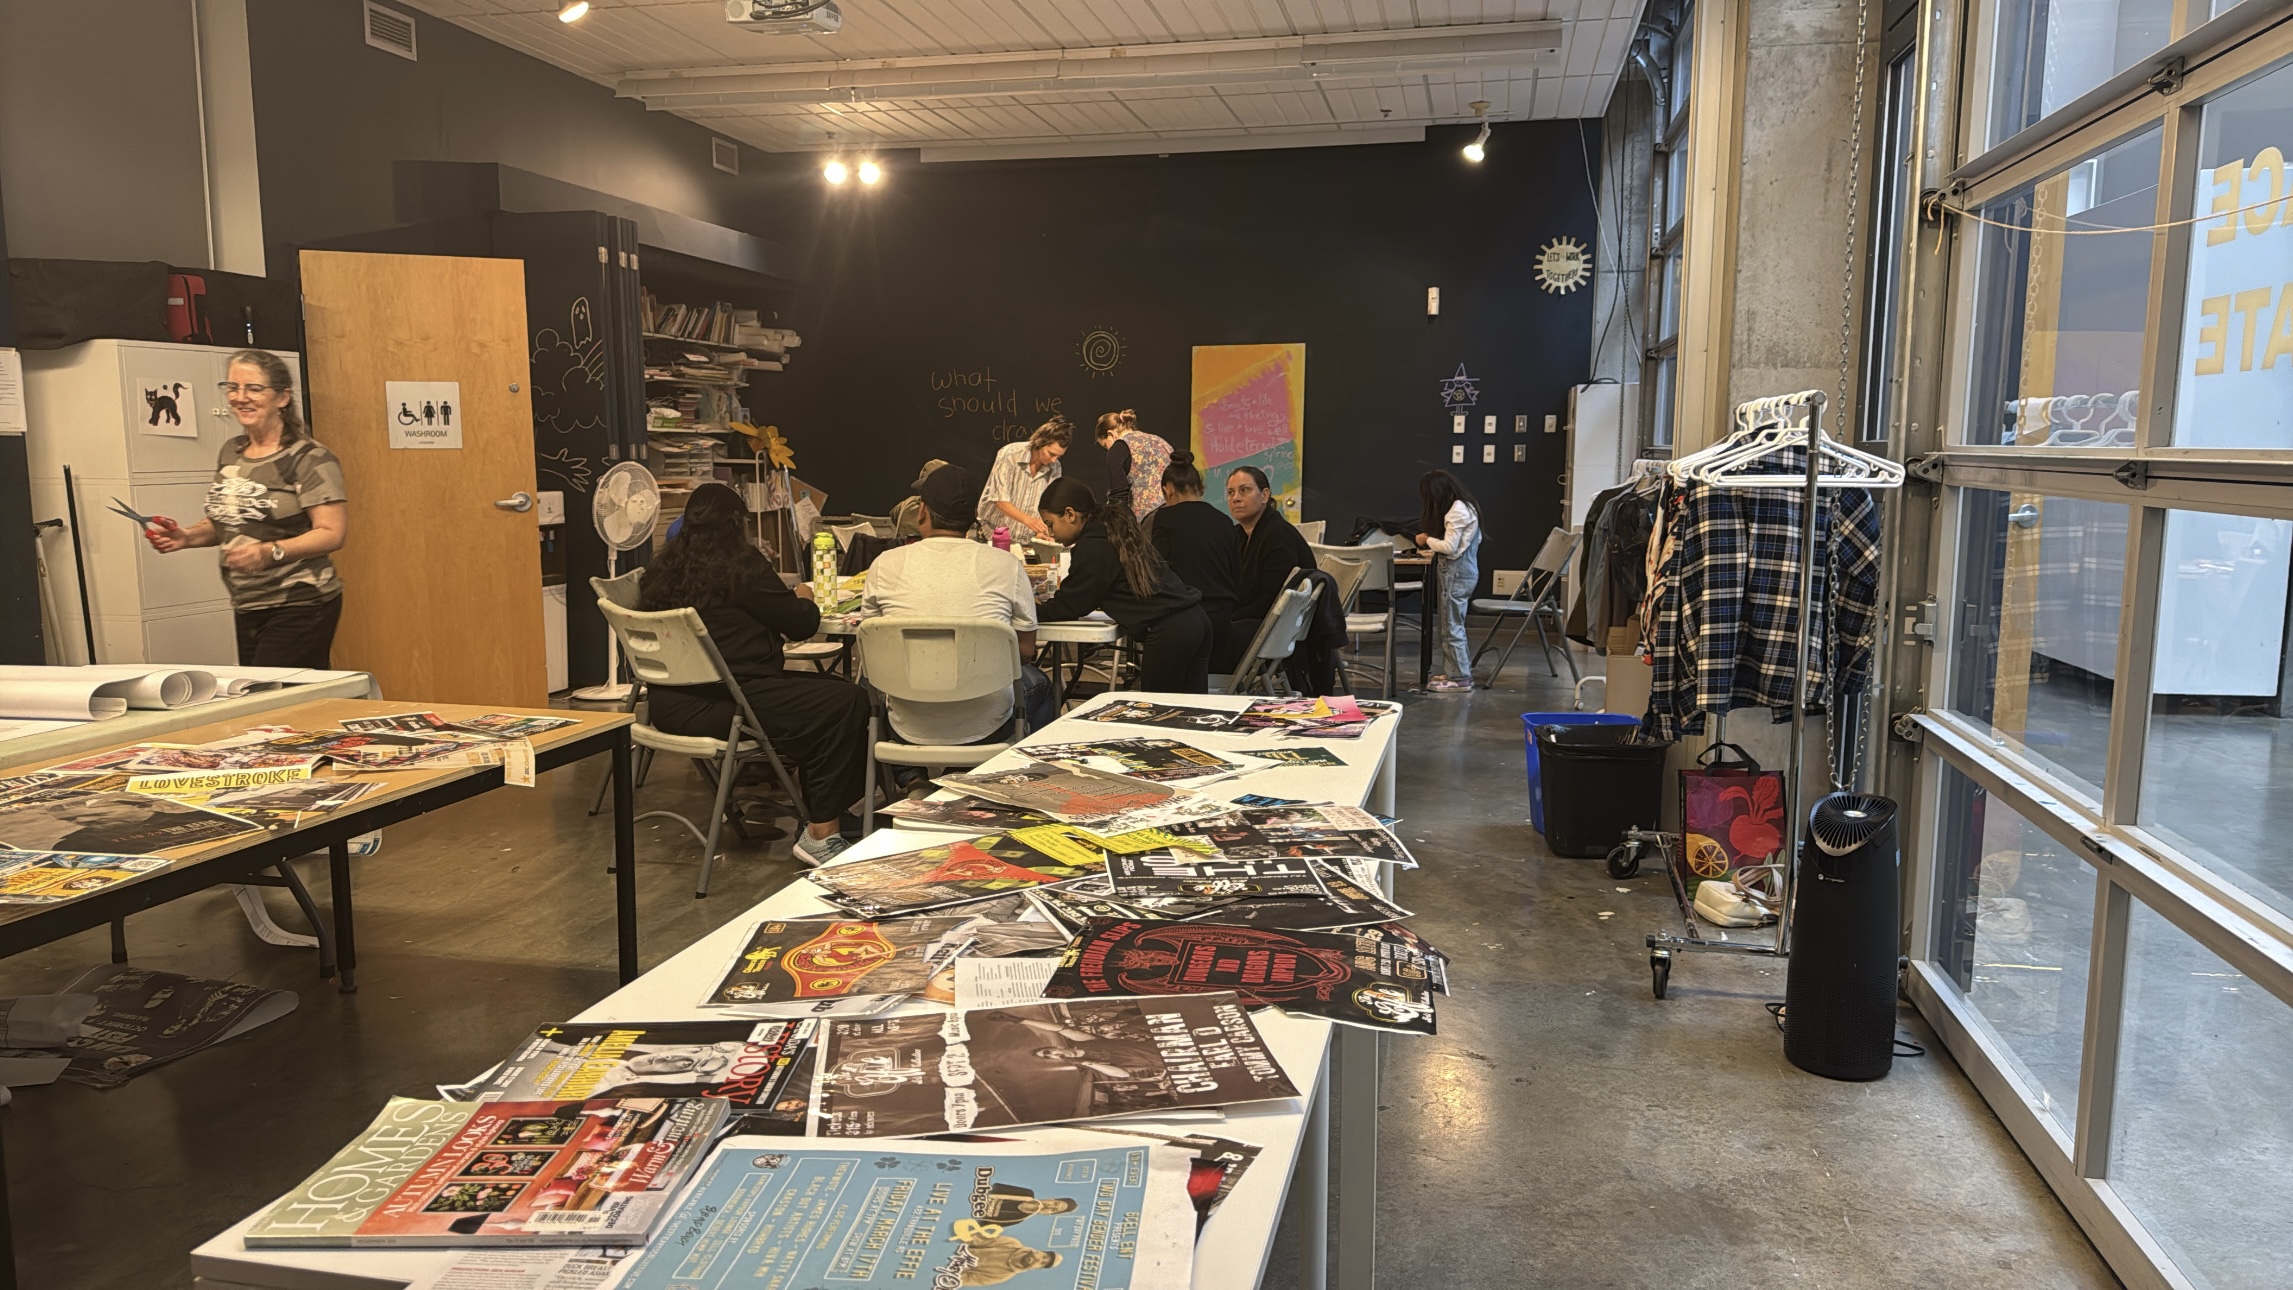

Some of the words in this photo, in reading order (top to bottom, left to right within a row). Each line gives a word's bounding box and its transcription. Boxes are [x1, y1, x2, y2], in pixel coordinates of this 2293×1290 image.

[931, 366, 997, 392] what
[938, 389, 1017, 418] should
[1035, 396, 1062, 413] we
[405, 430, 448, 442] WASHROOM
[992, 419, 1033, 442] dra
[138, 768, 302, 790] LOVESTROKE
[1098, 921, 1142, 940] SLIPS
[1080, 939, 1115, 976] FREUDIAN
[1181, 945, 1218, 981] DUNGEONS
[1238, 949, 1273, 983] DRAGONS
[1269, 953, 1298, 982] IMPROV
[1087, 979, 1111, 992] THE
[1211, 1004, 1256, 1043] CARSON
[587, 1029, 648, 1059] AMELIA
[1144, 1012, 1218, 1093] CHAIRMAN
[1197, 1038, 1240, 1068] EARL
[701, 1021, 796, 1105] STORY
[1234, 1046, 1280, 1082] TOMMY
[951, 1108, 967, 1128] Doors
[628, 1154, 668, 1182] Warm
[659, 1101, 706, 1140] inviting
[263, 1104, 444, 1231] HOMES
[334, 1205, 374, 1221] &
[358, 1111, 467, 1201] GARDENS
[386, 1159, 457, 1216] AUTUMN
[442, 1115, 498, 1155] LOOKS
[878, 1180, 914, 1215] FRIDAY,
[926, 1183, 951, 1204] LIVE
[968, 1166, 994, 1217] Dubgee
[1098, 1180, 1115, 1196] TWO
[603, 1195, 634, 1228] DECORATING
[918, 1208, 942, 1222] AT
[1094, 1200, 1111, 1216] DAY
[775, 1211, 805, 1238] ARTISTS
[862, 1218, 895, 1248] MARCH
[908, 1226, 934, 1243] THE
[1086, 1219, 1108, 1250] BENDER
[1108, 1222, 1123, 1249] PRESENTS
[847, 1254, 878, 1278] 17TH
[893, 1248, 925, 1278] EFFIE
